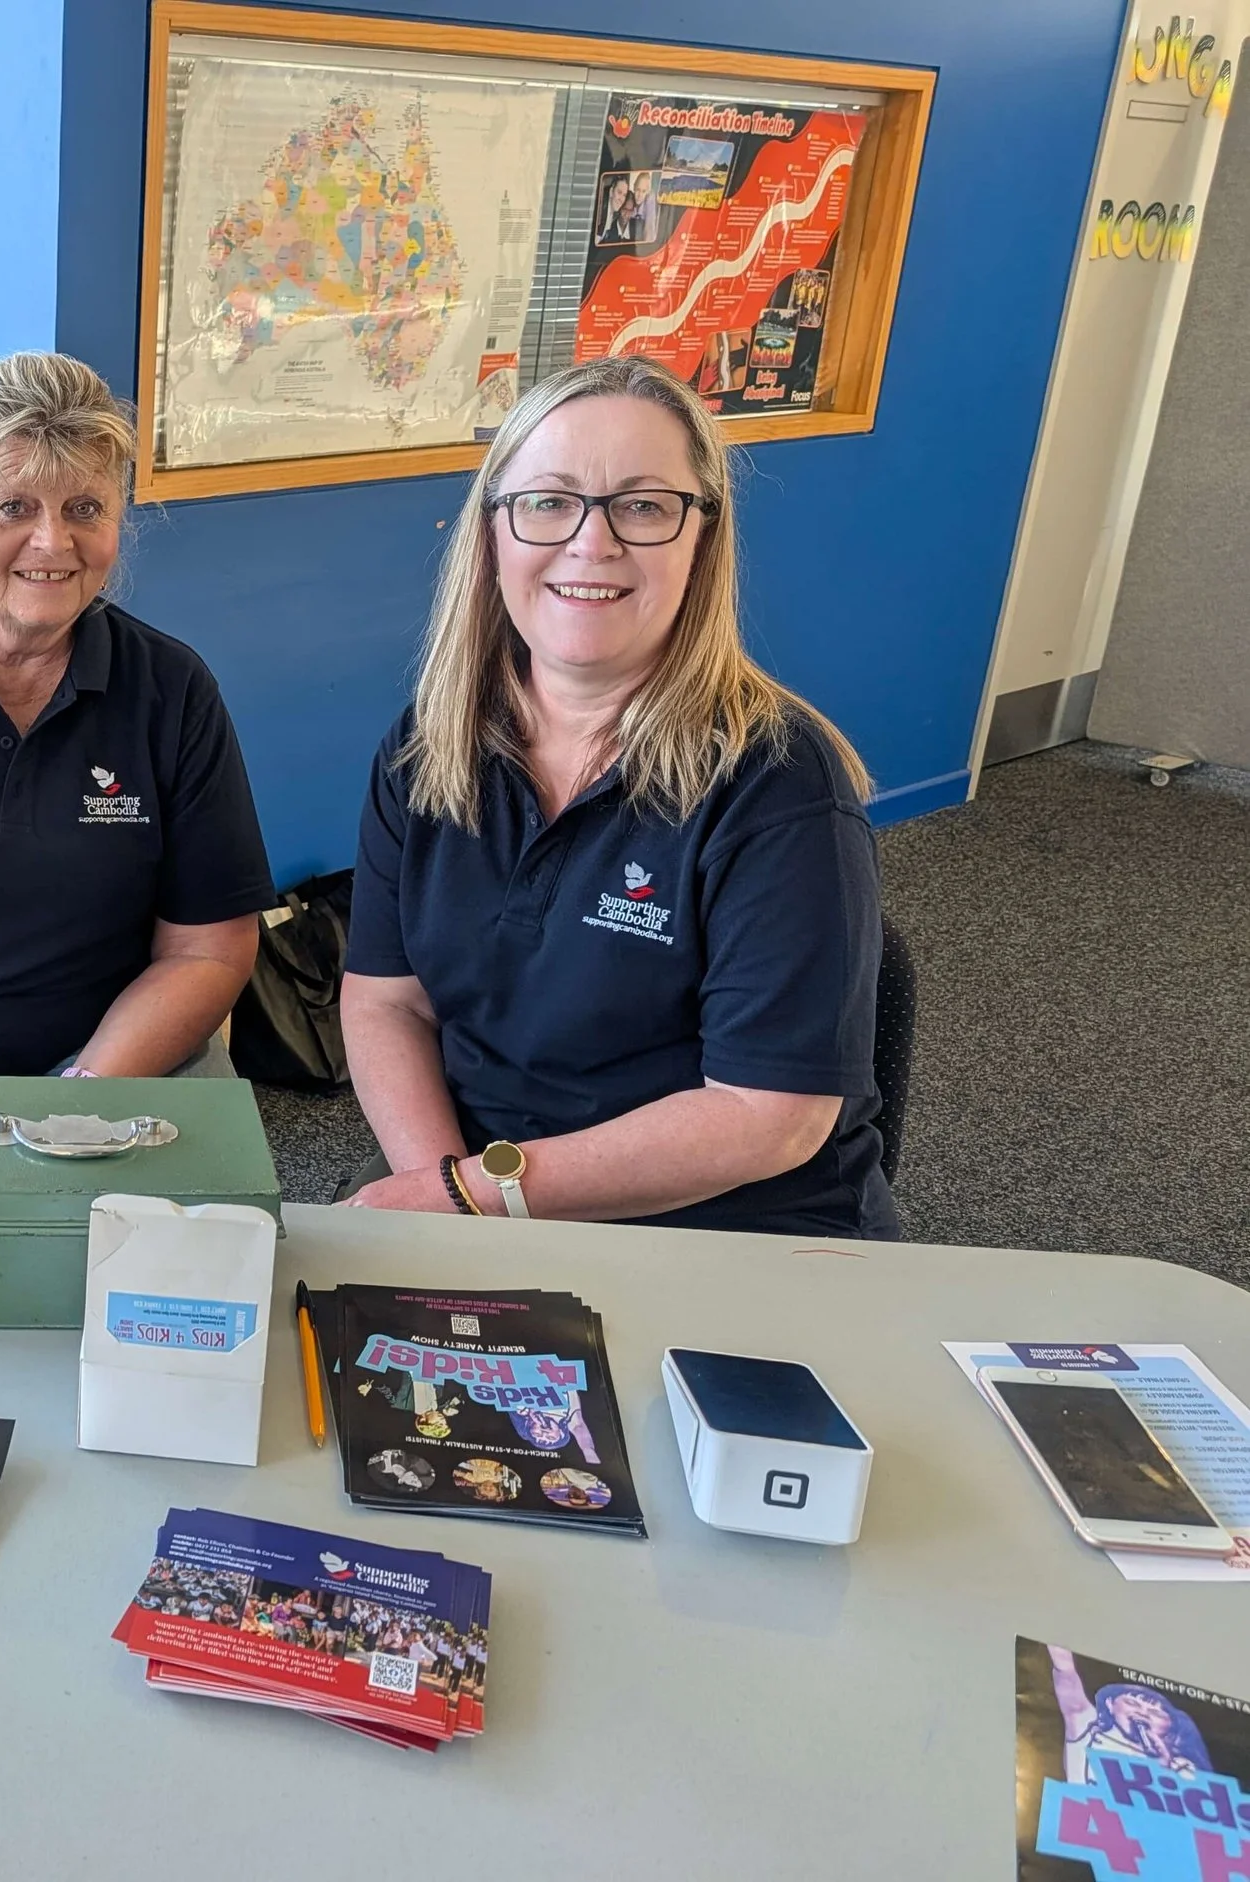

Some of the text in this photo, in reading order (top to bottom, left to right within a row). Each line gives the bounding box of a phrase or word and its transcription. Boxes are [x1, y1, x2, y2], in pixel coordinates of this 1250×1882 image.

[637, 101, 795, 137] Reconciliation Timeline
[1089, 199, 1195, 263] ROOM
[791, 390, 811, 402] Focus
[83, 794, 141, 807] Supporting
[87, 805, 139, 816] Cambodia
[598, 892, 671, 922] Supporting
[598, 905, 662, 932] Cambodia
[581, 915, 674, 945] supportingcambodia.org
[137, 1323, 225, 1347] KIDS 4 KIDS
[411, 1335, 526, 1353] BENEFIT VARIETY SHOW
[367, 1339, 577, 1386] 4 Kids!
[474, 1385, 563, 1408] Kids
[405, 1435, 442, 1447] FINALISTS!
[354, 1562, 430, 1589] Supporting
[356, 1570, 426, 1596] Cambodia
[1058, 1796, 1146, 1876] 4
